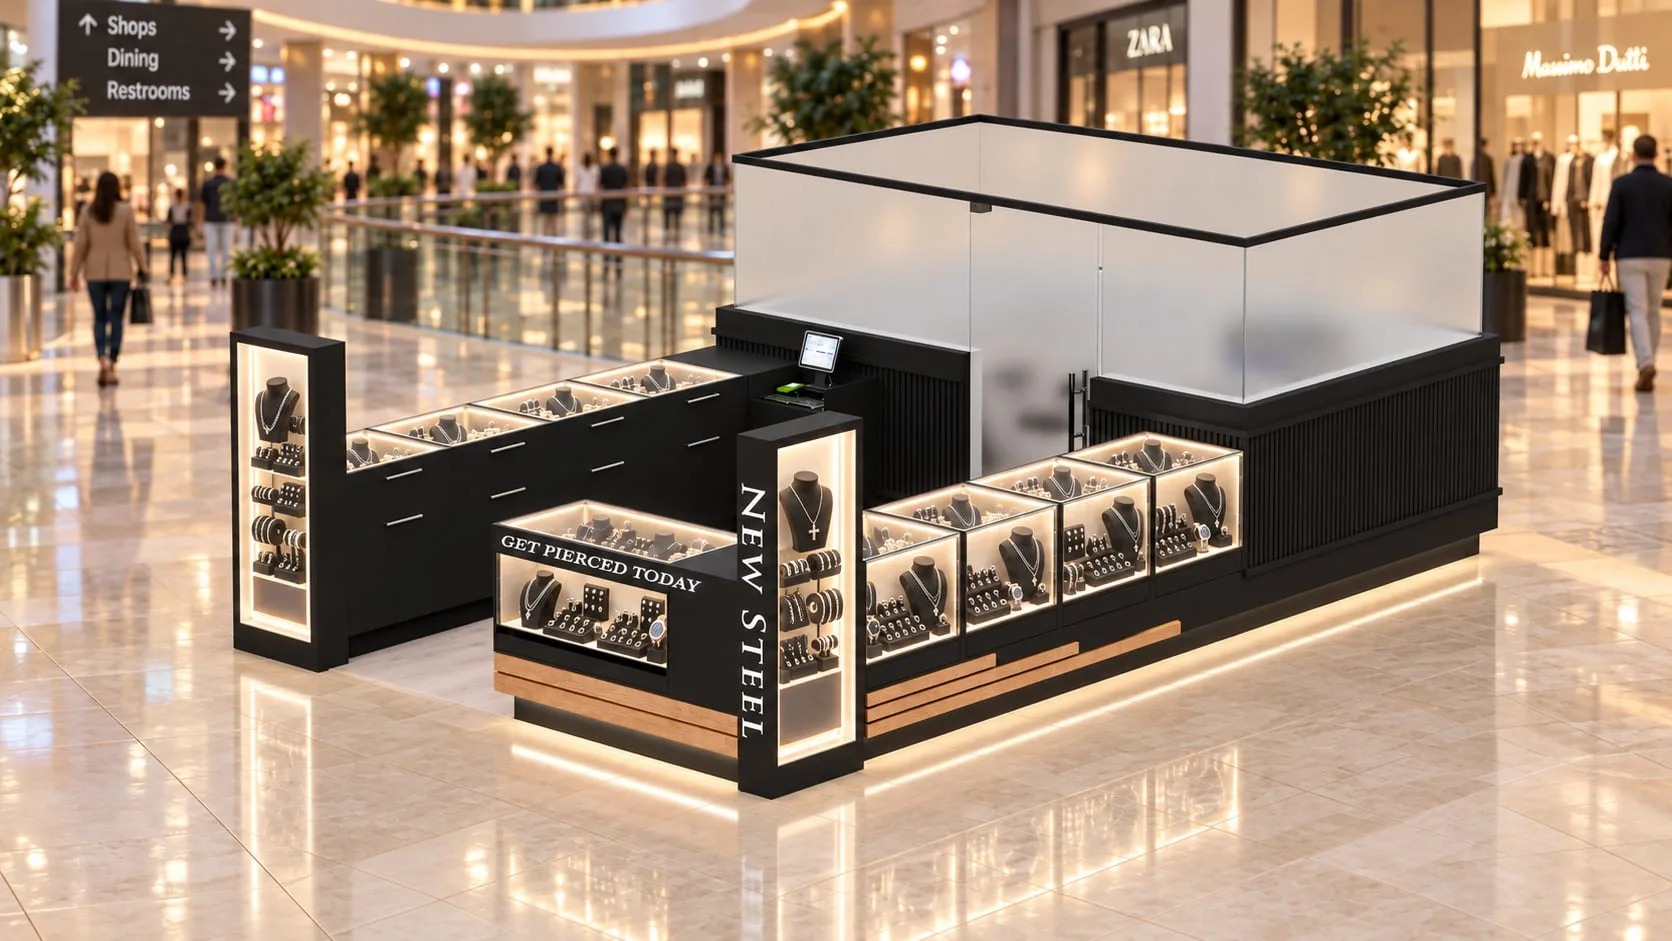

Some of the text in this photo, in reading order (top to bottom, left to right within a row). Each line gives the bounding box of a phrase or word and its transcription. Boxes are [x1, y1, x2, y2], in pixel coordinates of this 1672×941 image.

[107, 15, 157, 39] Shops
[1126, 23, 1174, 59] ZARA
[107, 47, 160, 72] Dining
[1521, 44, 1650, 79] Massimo Dutti
[107, 80, 191, 101] Restrooms
[501, 535, 702, 593] GET PIERCED TODAY
[741, 482, 767, 739] NEW STEEL
